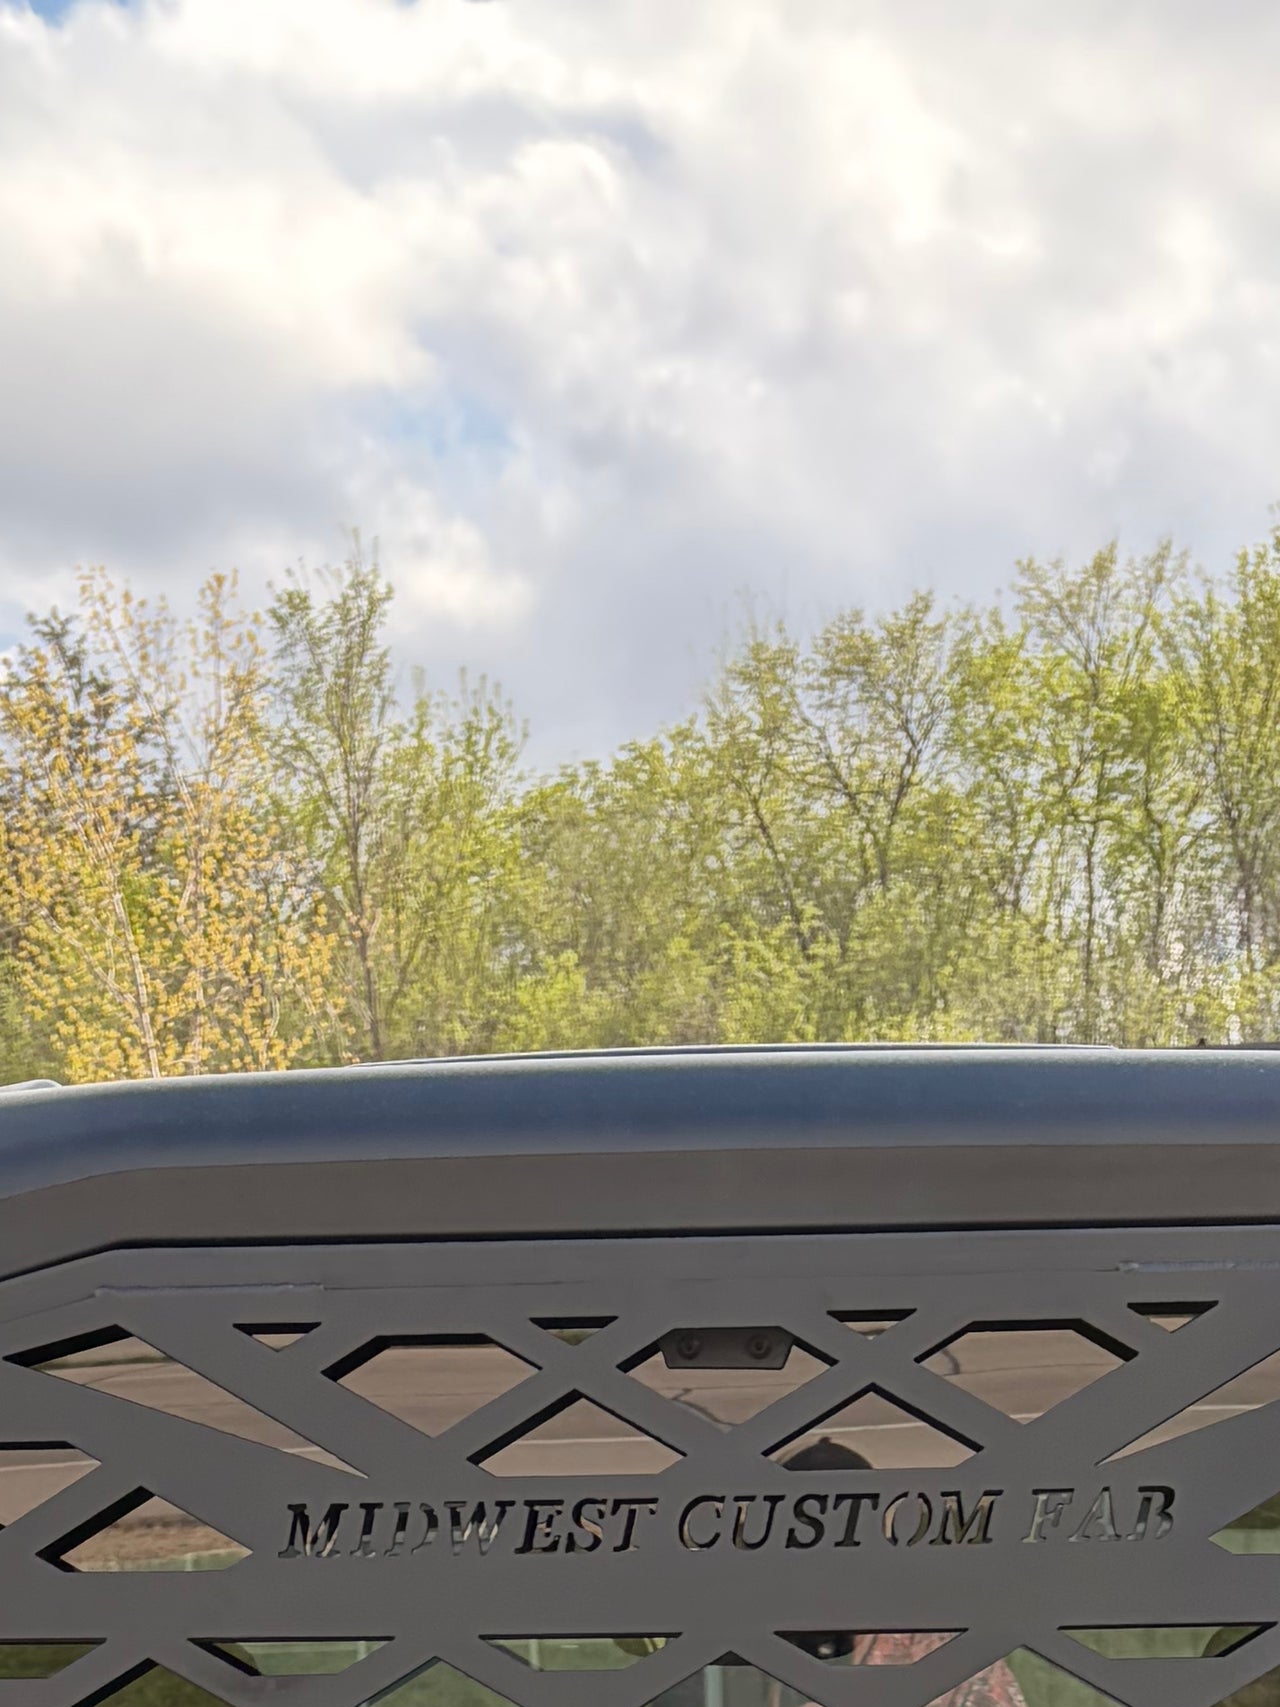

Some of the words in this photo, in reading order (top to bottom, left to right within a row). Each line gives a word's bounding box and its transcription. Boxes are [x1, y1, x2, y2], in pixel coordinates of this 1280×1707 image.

[277, 1496, 657, 1559] MIDWEST
[678, 1488, 1004, 1552] CUSTOM
[1020, 1484, 1176, 1544] FAB
